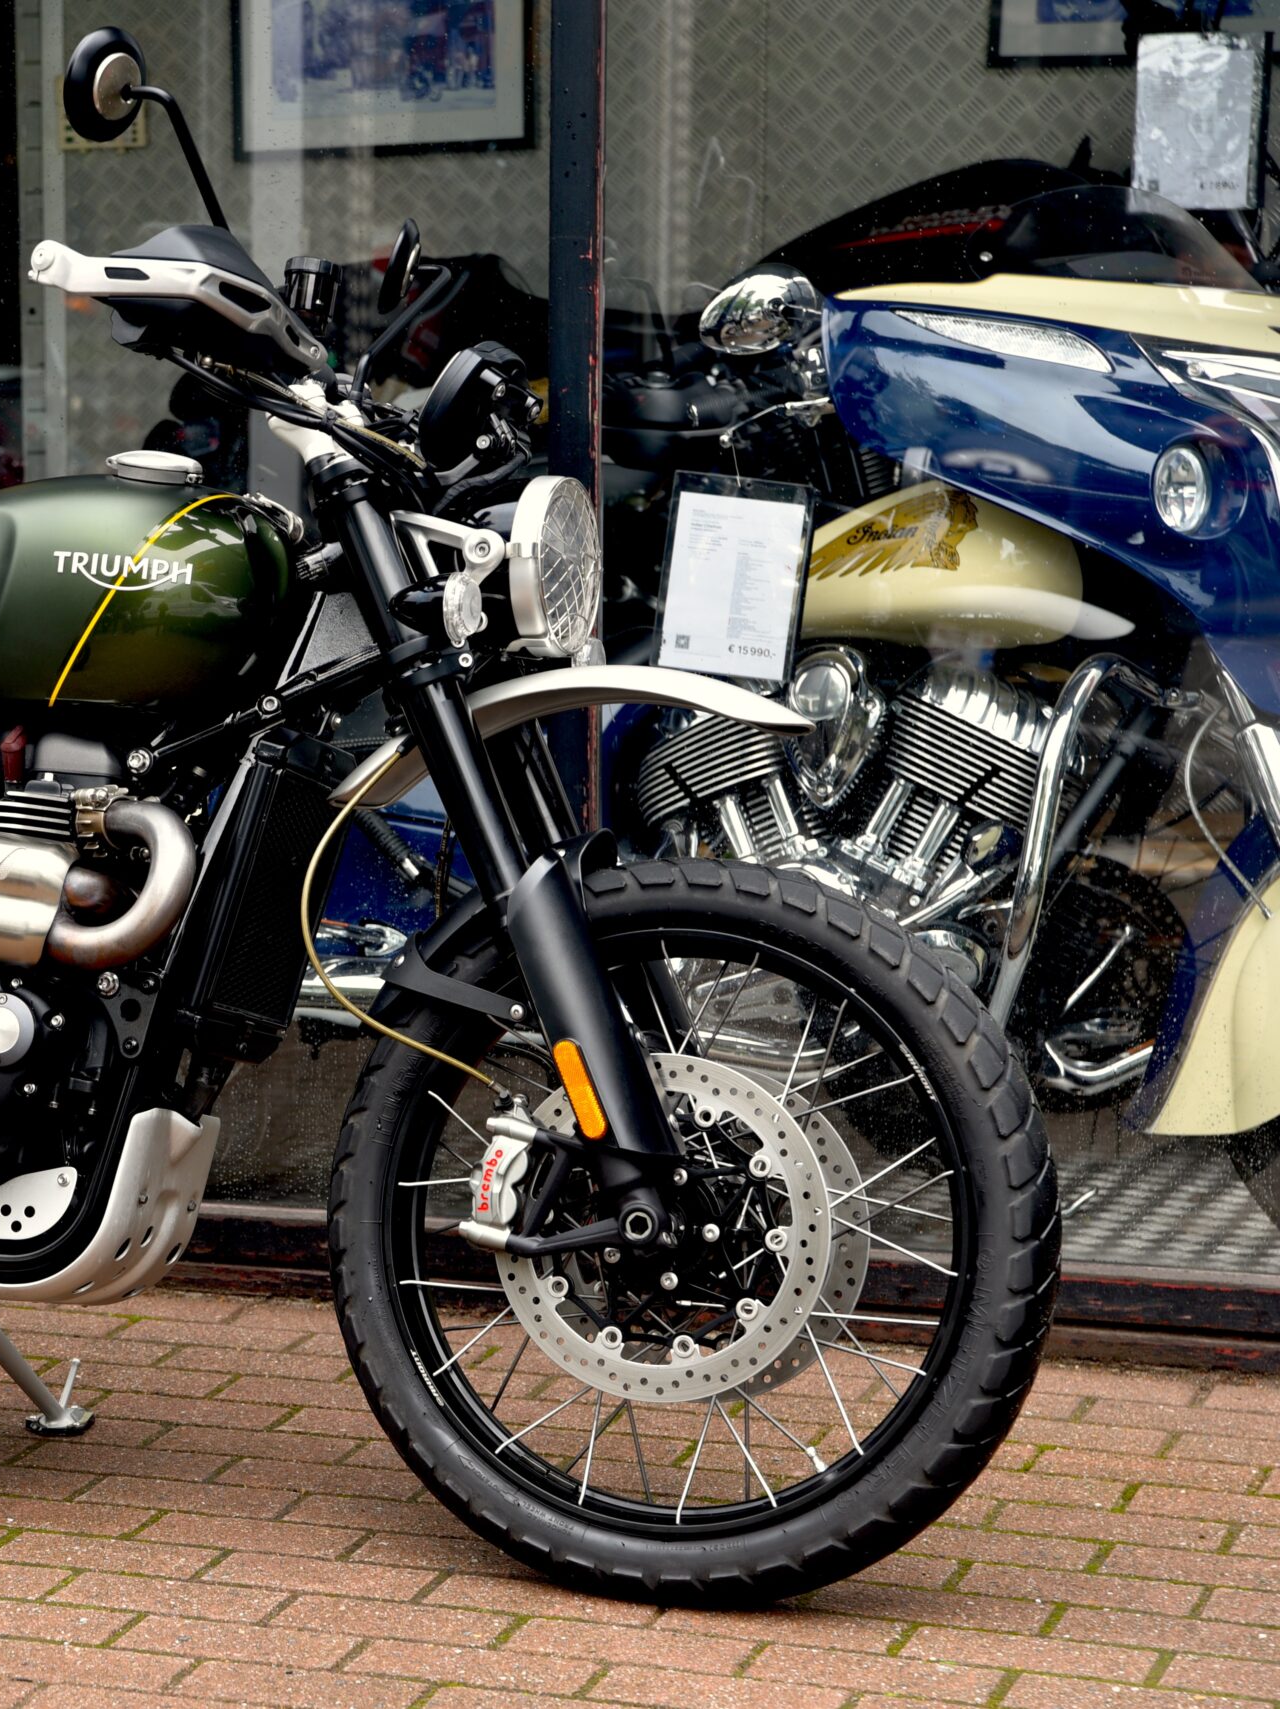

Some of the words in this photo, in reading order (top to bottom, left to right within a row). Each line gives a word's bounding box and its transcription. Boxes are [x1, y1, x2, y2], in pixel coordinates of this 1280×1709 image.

[846, 521, 919, 546] Indian
[53, 549, 195, 590] TRIUMPH
[728, 644, 736, 654] €
[477, 1149, 504, 1213] brembo
